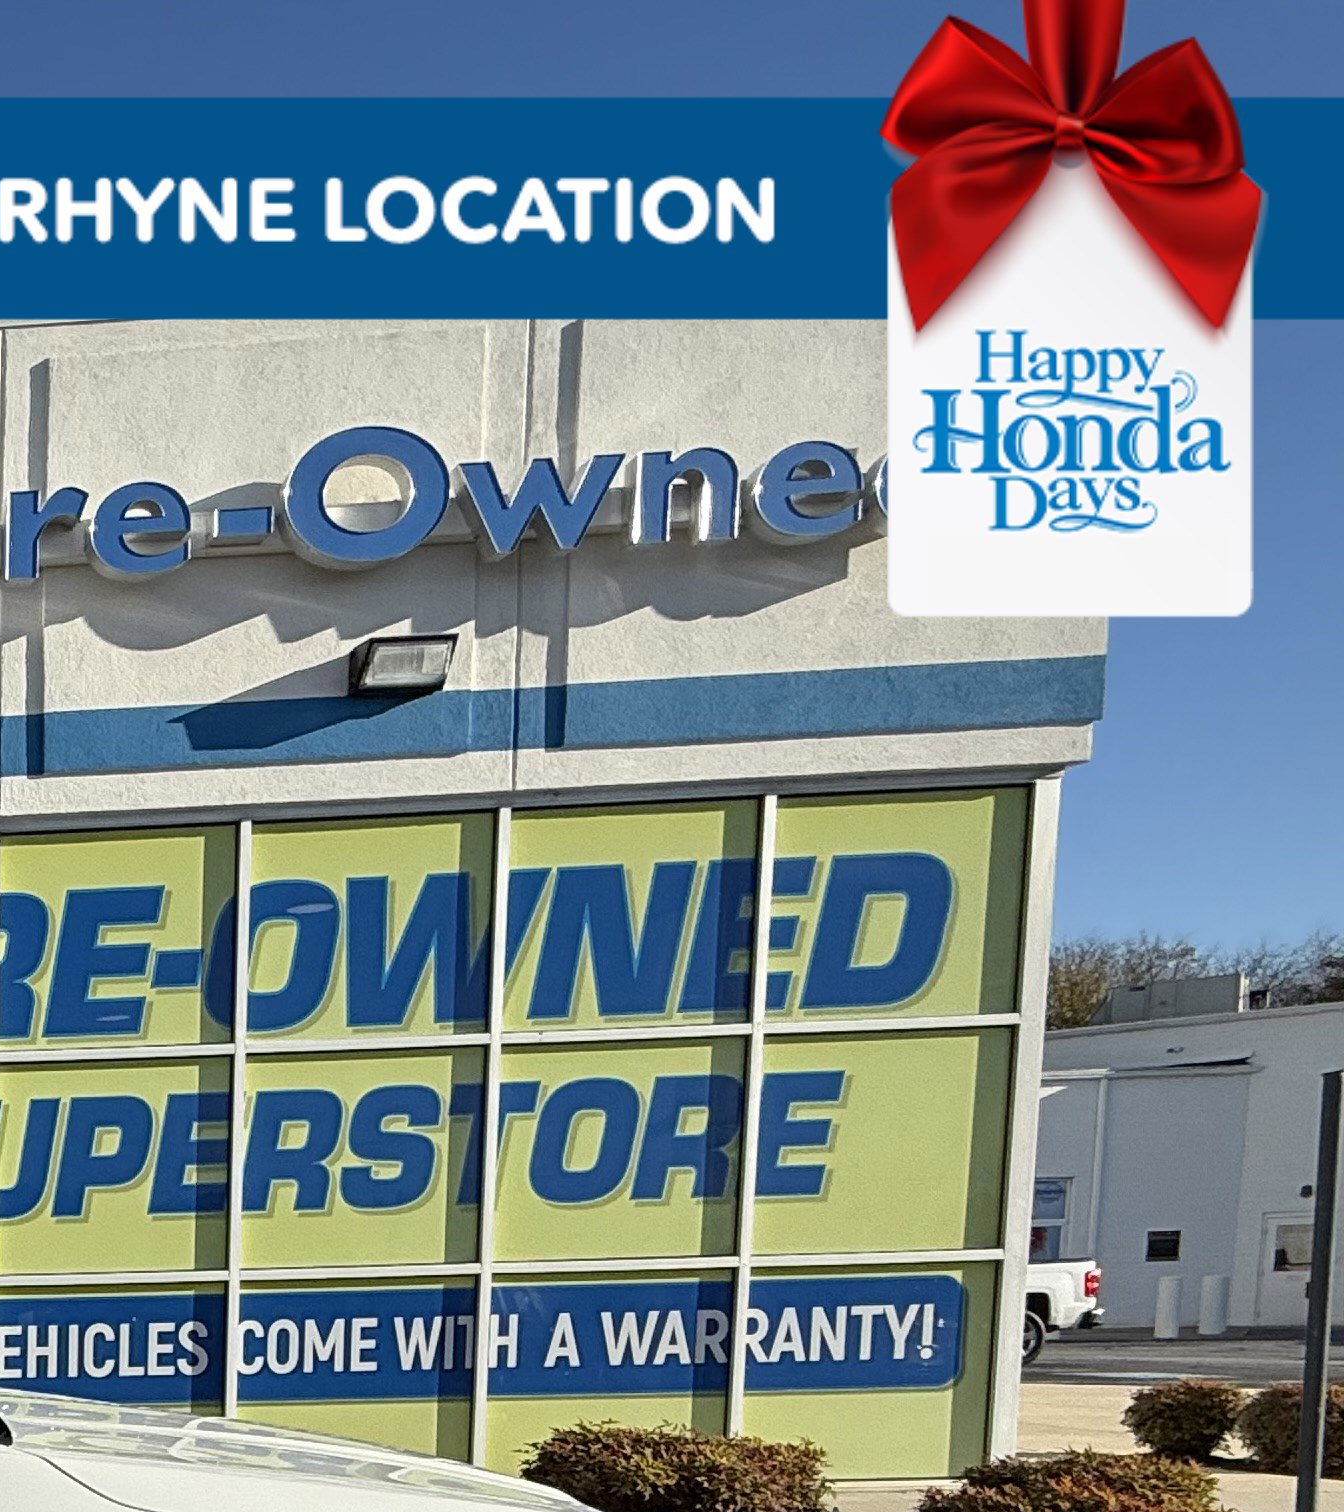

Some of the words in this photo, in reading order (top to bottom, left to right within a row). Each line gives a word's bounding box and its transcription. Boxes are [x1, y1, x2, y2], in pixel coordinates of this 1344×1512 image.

[237, 1317, 378, 1375] COME
[393, 1313, 519, 1371] WITH
[543, 1312, 581, 1367] A
[600, 1303, 936, 1366] WARRANTY!
